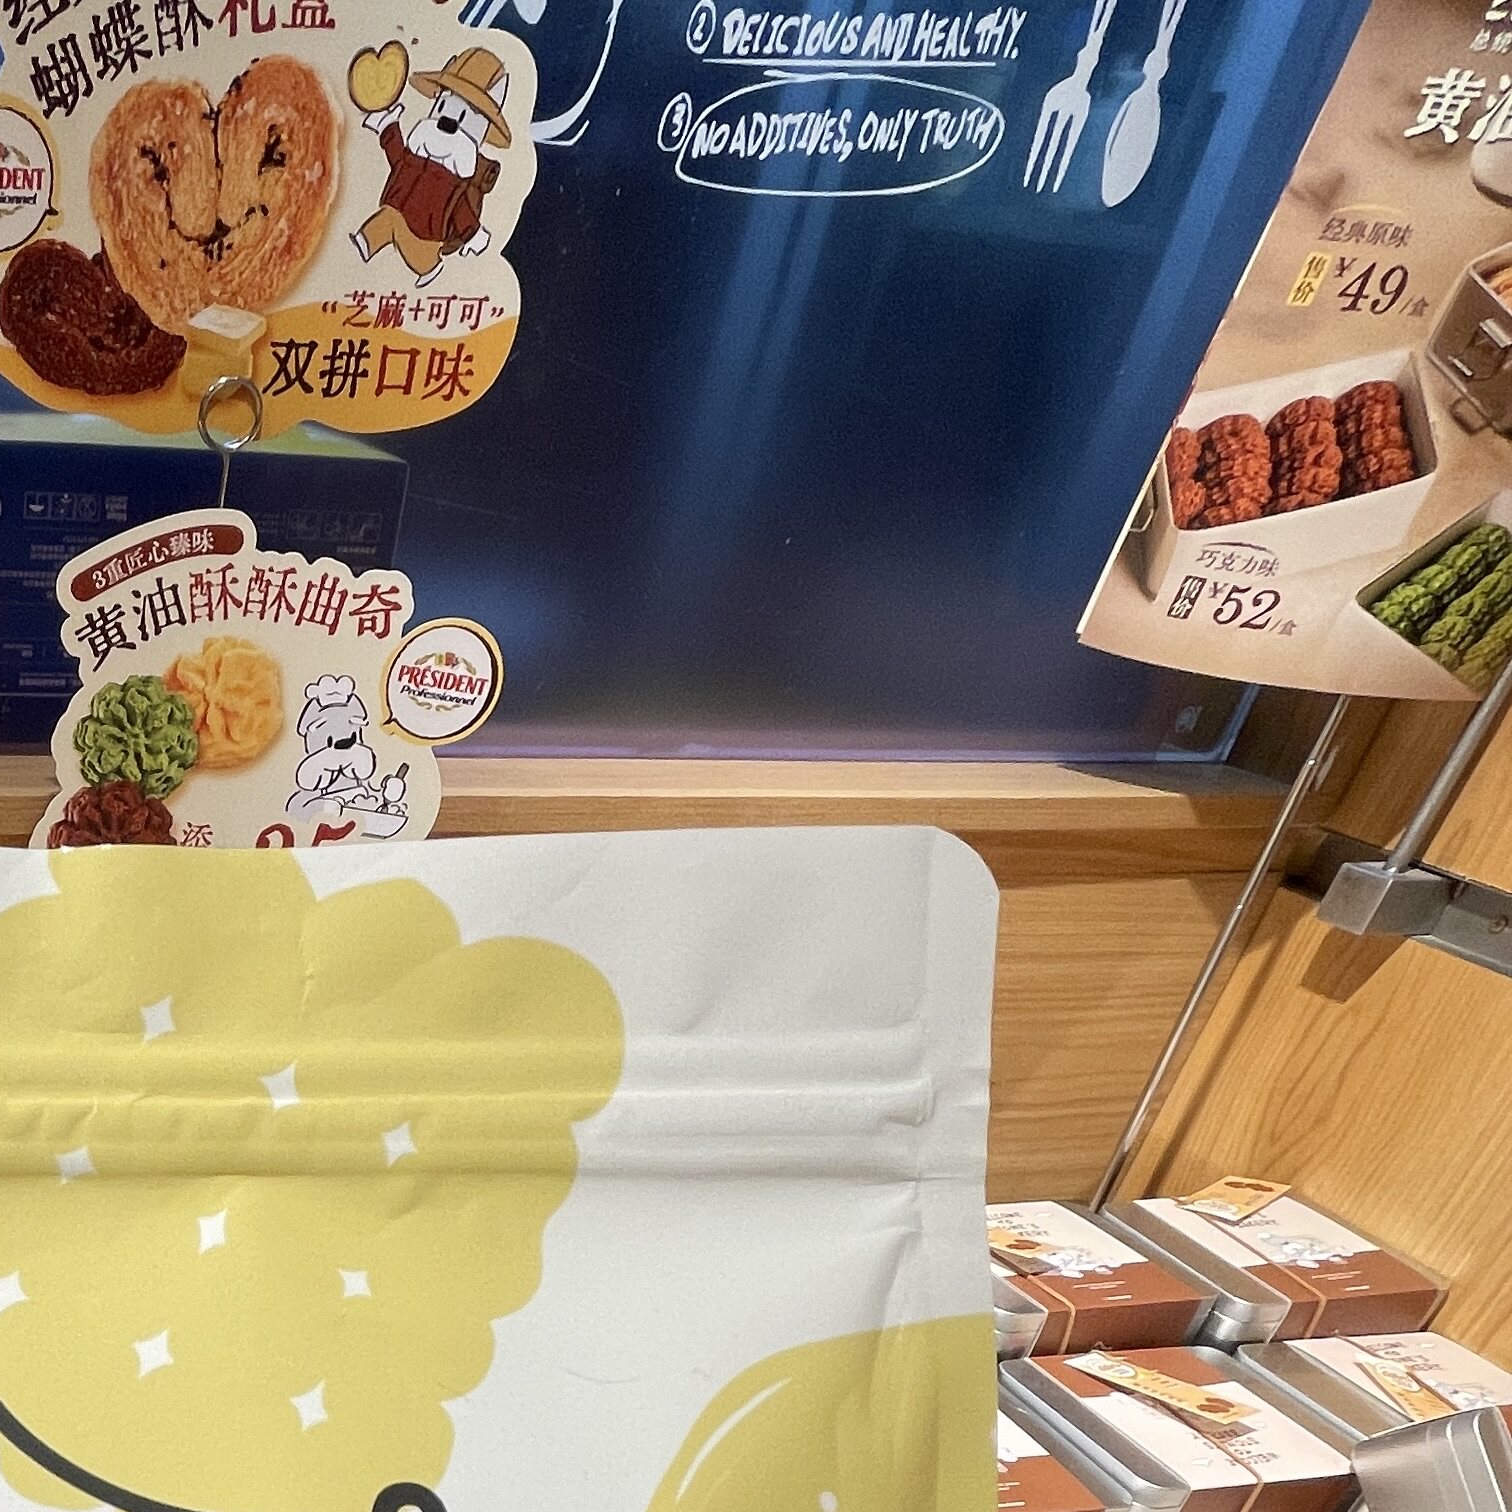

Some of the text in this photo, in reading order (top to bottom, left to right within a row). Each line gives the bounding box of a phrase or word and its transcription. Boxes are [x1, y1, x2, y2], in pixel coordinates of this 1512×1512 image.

[723, 8, 862, 56] DELICIOUS
[861, 11, 915, 62] AND
[912, 7, 1027, 62] HEALTHY.
[692, 121, 730, 159] NO
[729, 108, 853, 162] ADDITIVES,
[858, 108, 919, 162] ONLY
[919, 106, 996, 154] TRUTH
[262, 338, 475, 402] 双拼口味
[1195, 549, 1281, 578] 巧克力味
[74, 562, 403, 672] 黄油酥酥曲奇
[397, 664, 489, 696] PRÉSIDENT
